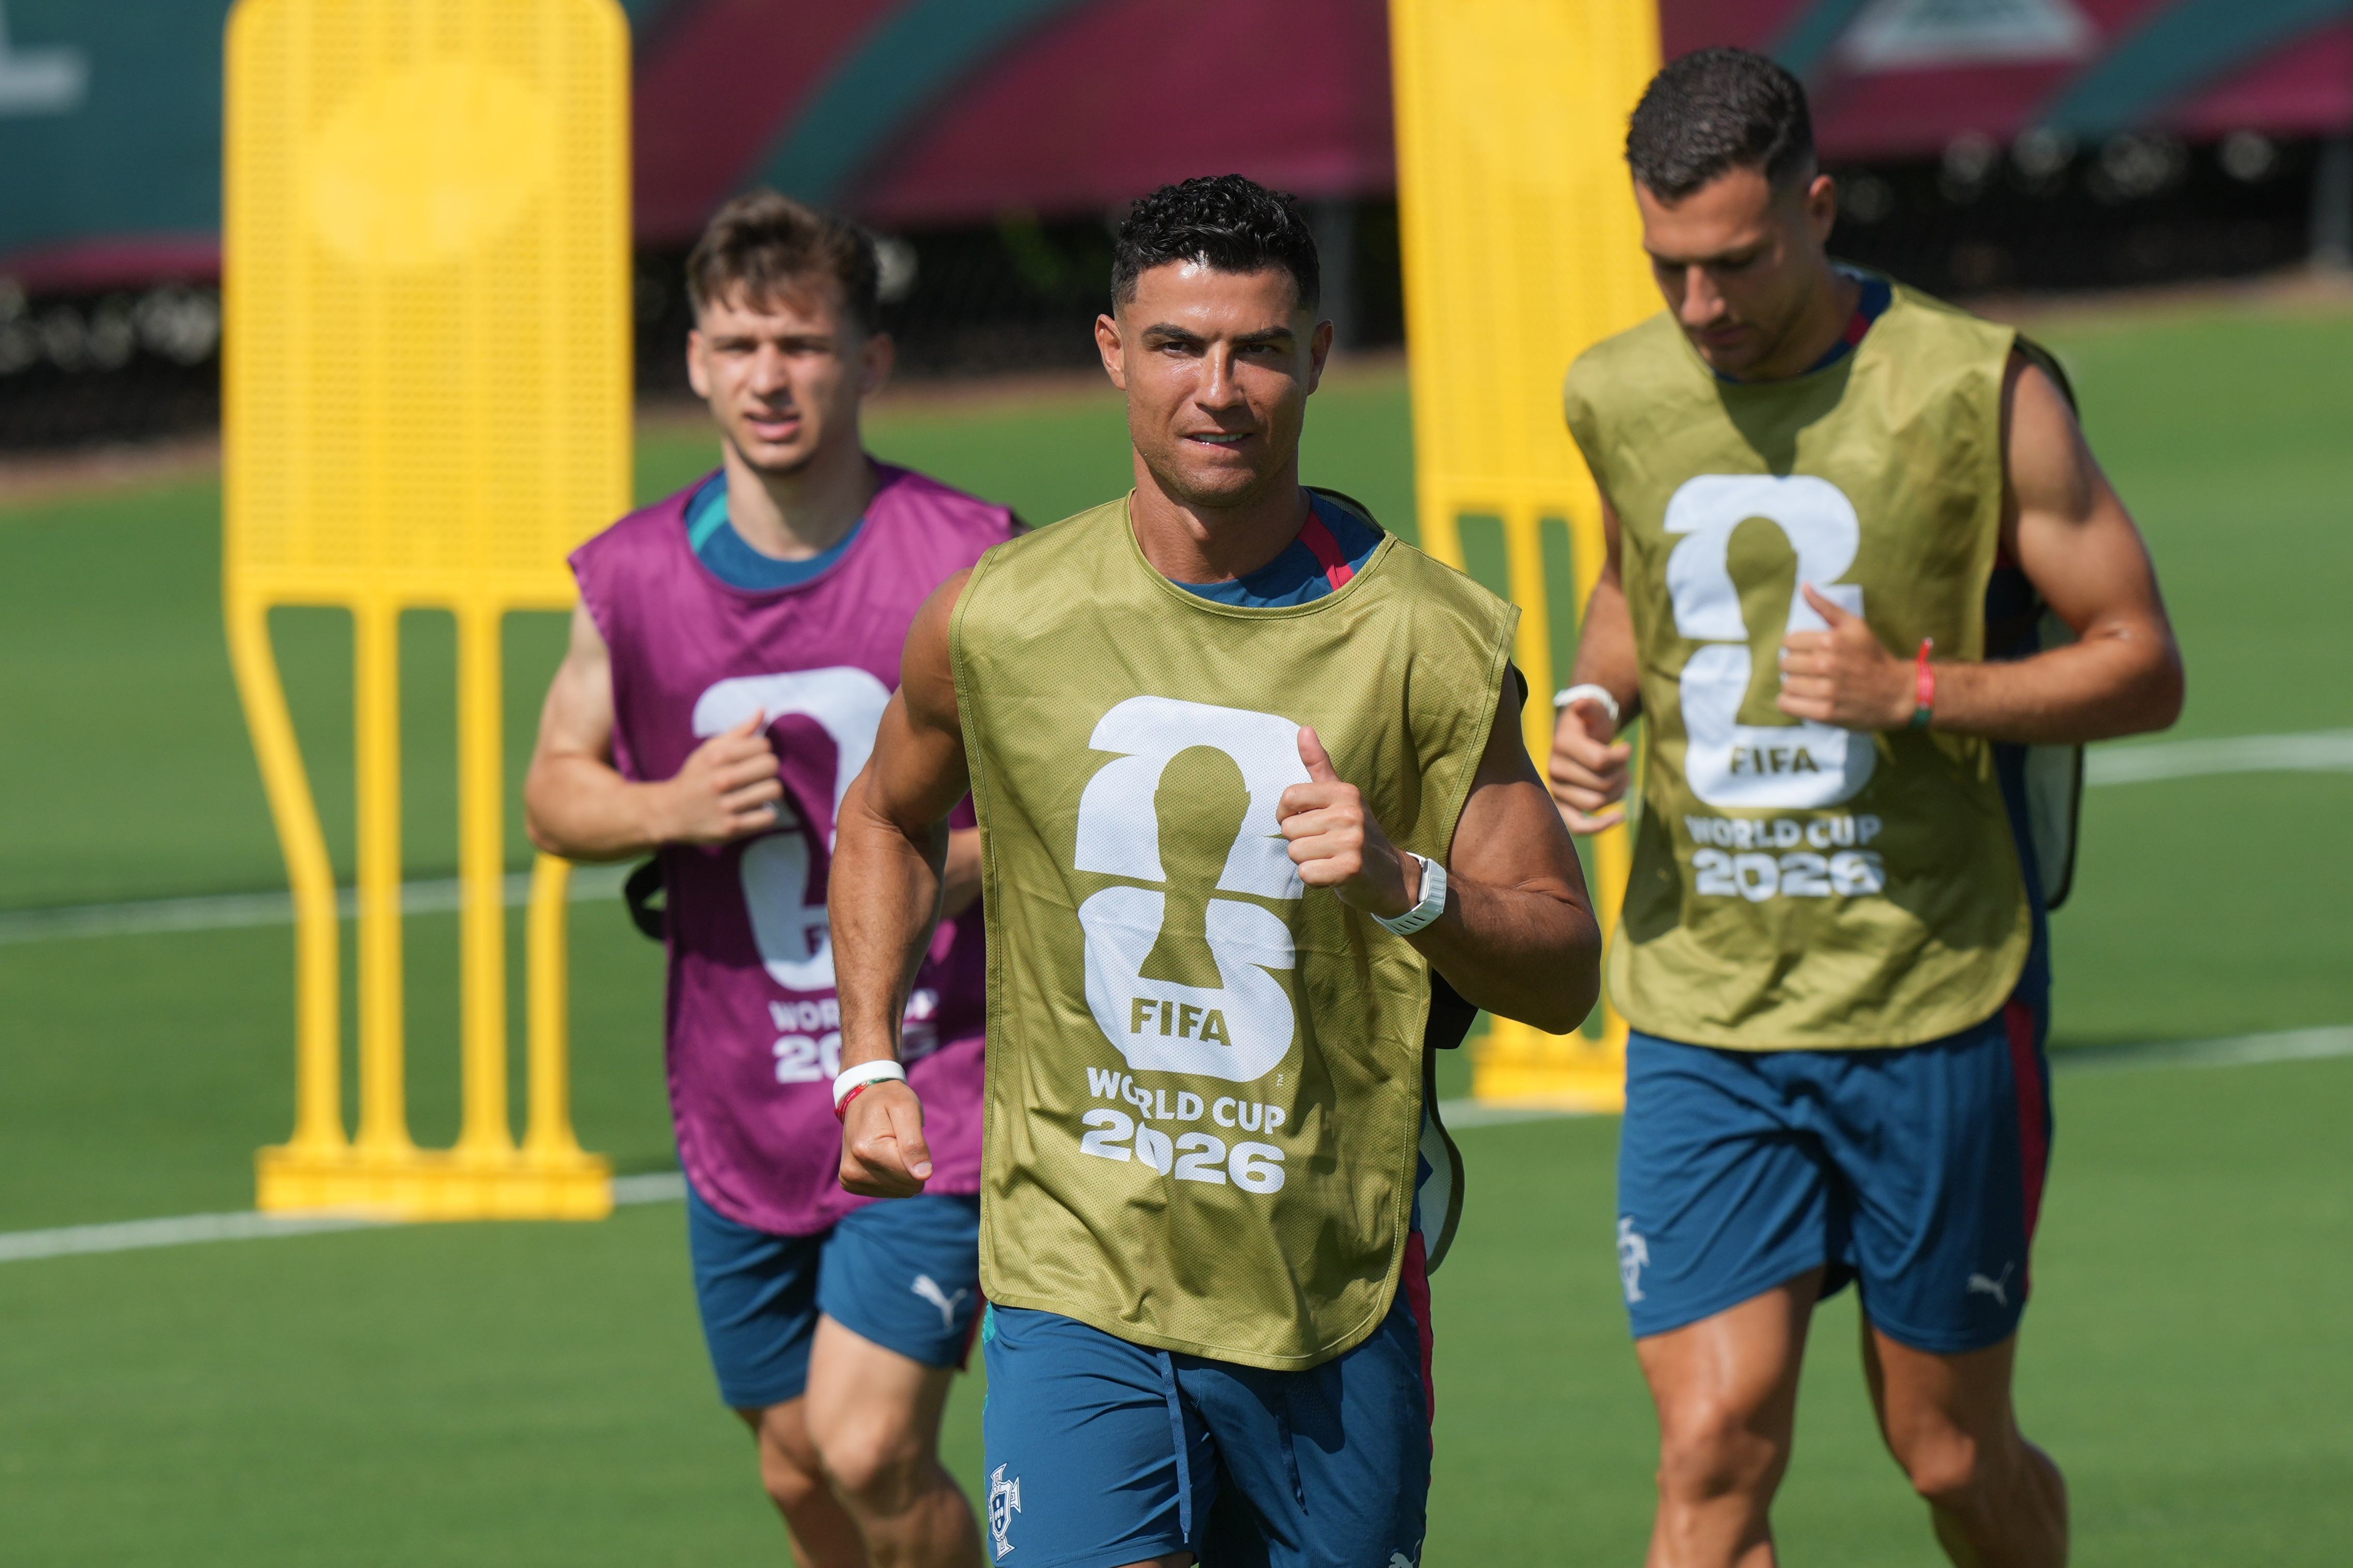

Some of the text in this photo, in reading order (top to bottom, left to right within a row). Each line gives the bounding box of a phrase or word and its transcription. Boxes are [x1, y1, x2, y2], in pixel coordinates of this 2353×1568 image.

[1730, 744, 1818, 774] FIFA
[1684, 814, 1883, 850] WORLD CUP
[1692, 848, 1886, 902] 2026
[768, 998, 841, 1032] WOR
[1130, 997, 1231, 1046] FIFA
[1086, 1067, 1286, 1134] WORLD CUP
[1080, 1107, 1286, 1194] 2026
